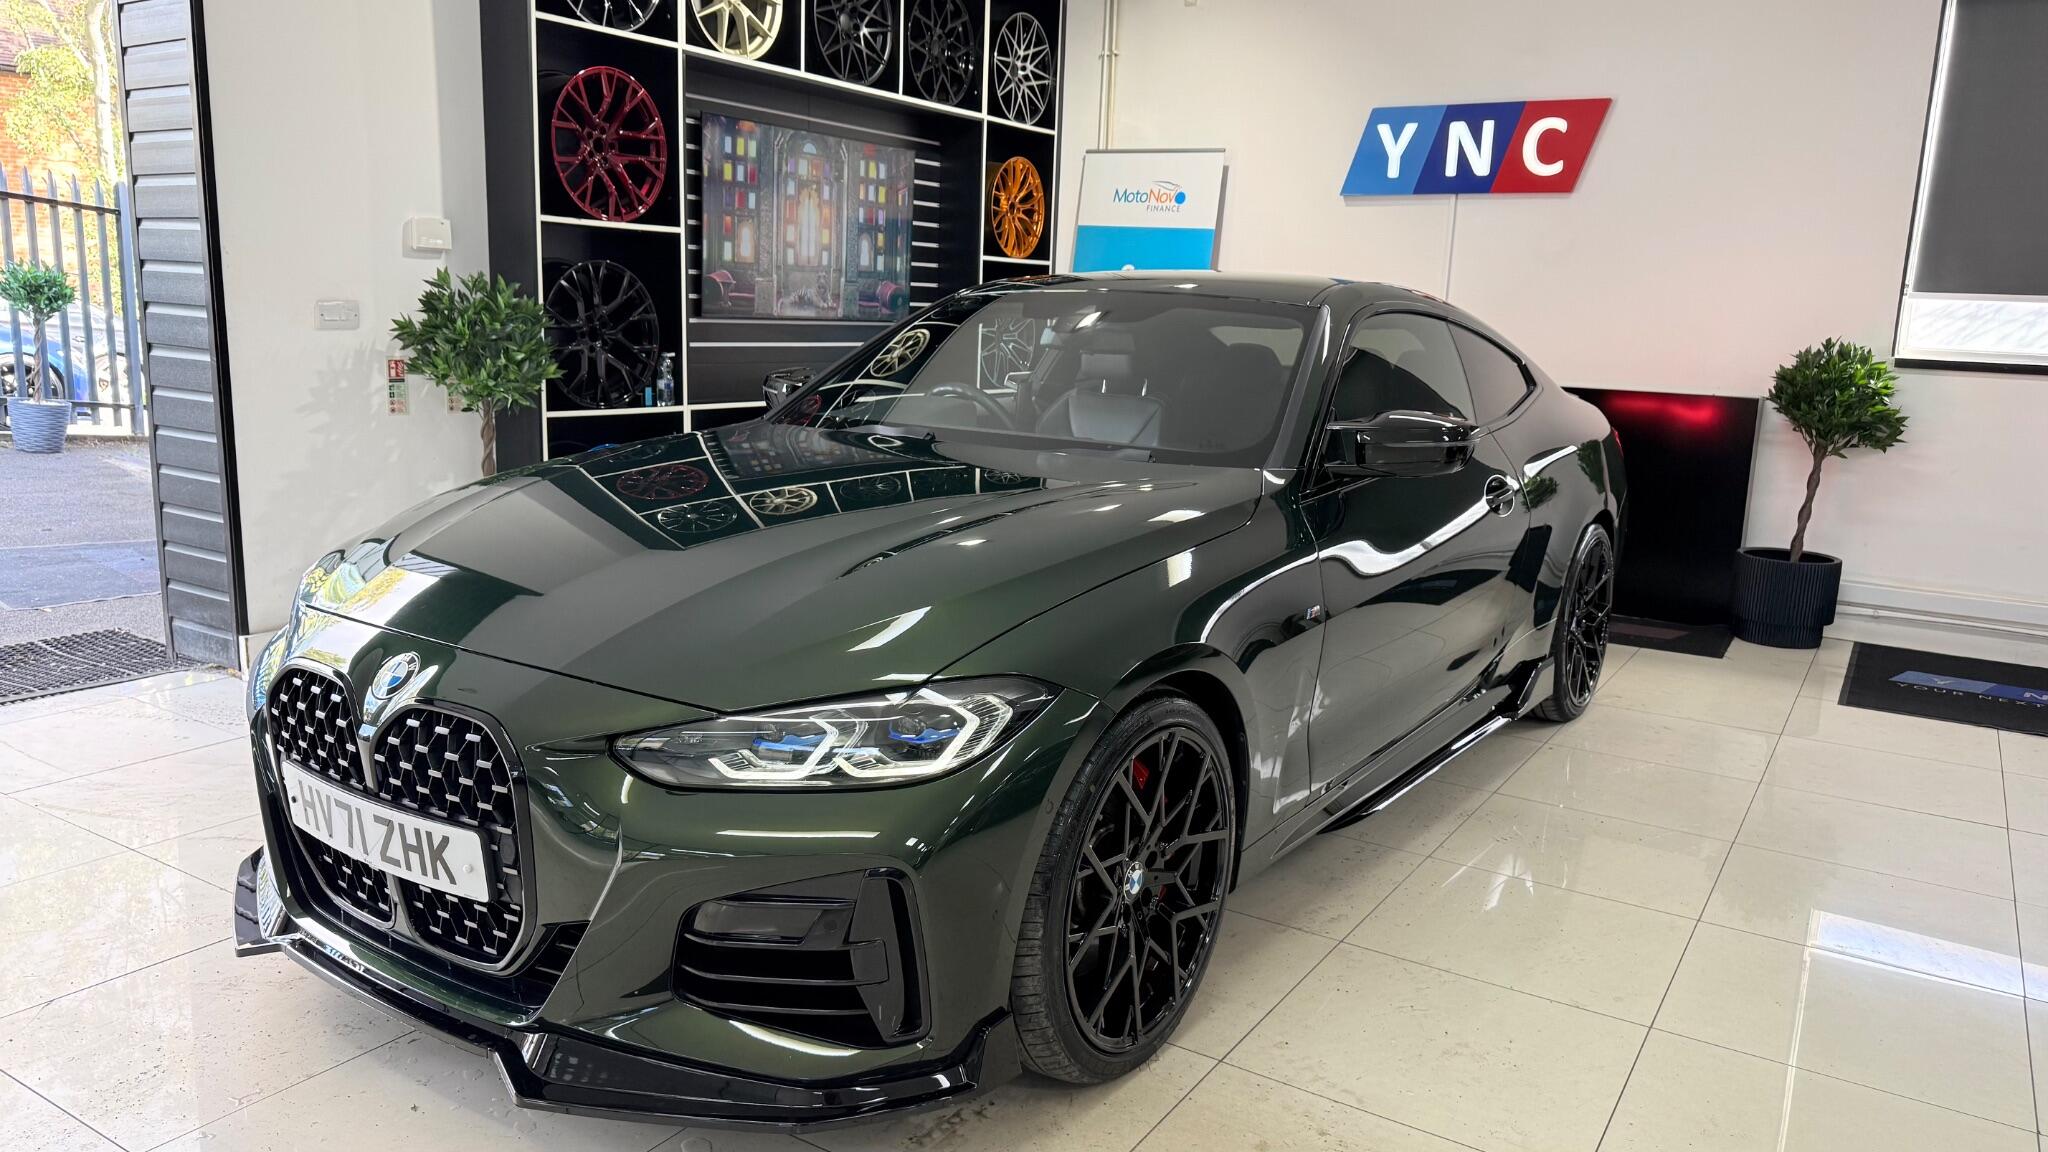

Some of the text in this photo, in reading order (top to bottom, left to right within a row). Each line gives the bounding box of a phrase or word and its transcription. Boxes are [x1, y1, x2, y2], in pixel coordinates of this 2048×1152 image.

[1376, 116, 1569, 179] YNC
[1146, 205, 1181, 213] FINANCE
[1896, 682, 2046, 708] YOUR NEXT
[297, 779, 457, 886] HV71 ZHK
